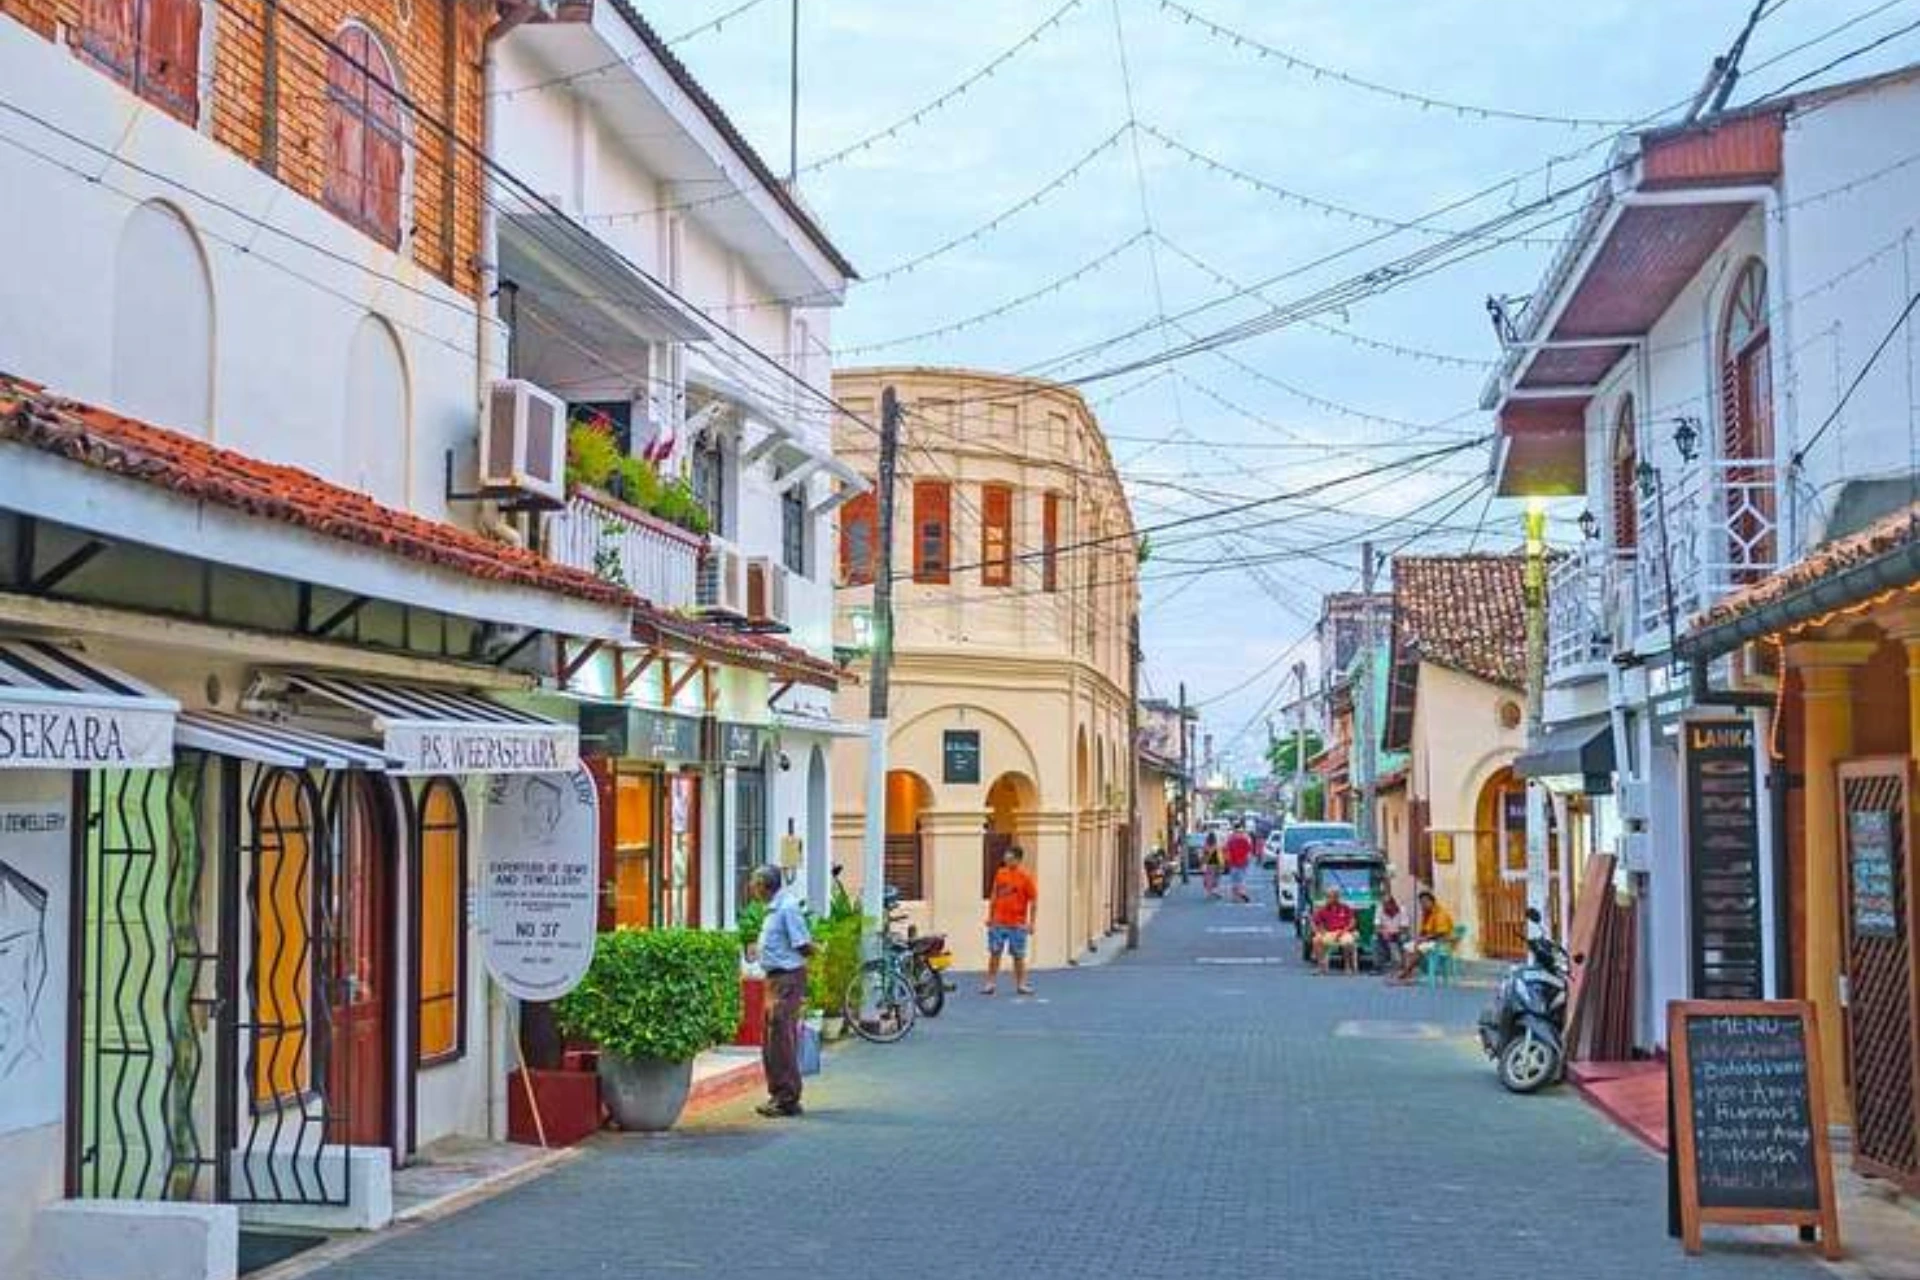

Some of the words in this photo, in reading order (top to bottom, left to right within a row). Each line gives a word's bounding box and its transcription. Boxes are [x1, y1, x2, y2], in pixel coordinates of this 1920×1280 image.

[1694, 728, 1752, 749] LANKA
[495, 874, 519, 886] AND
[541, 922, 561, 938] 37
[1711, 1017, 1779, 1035] MENU
